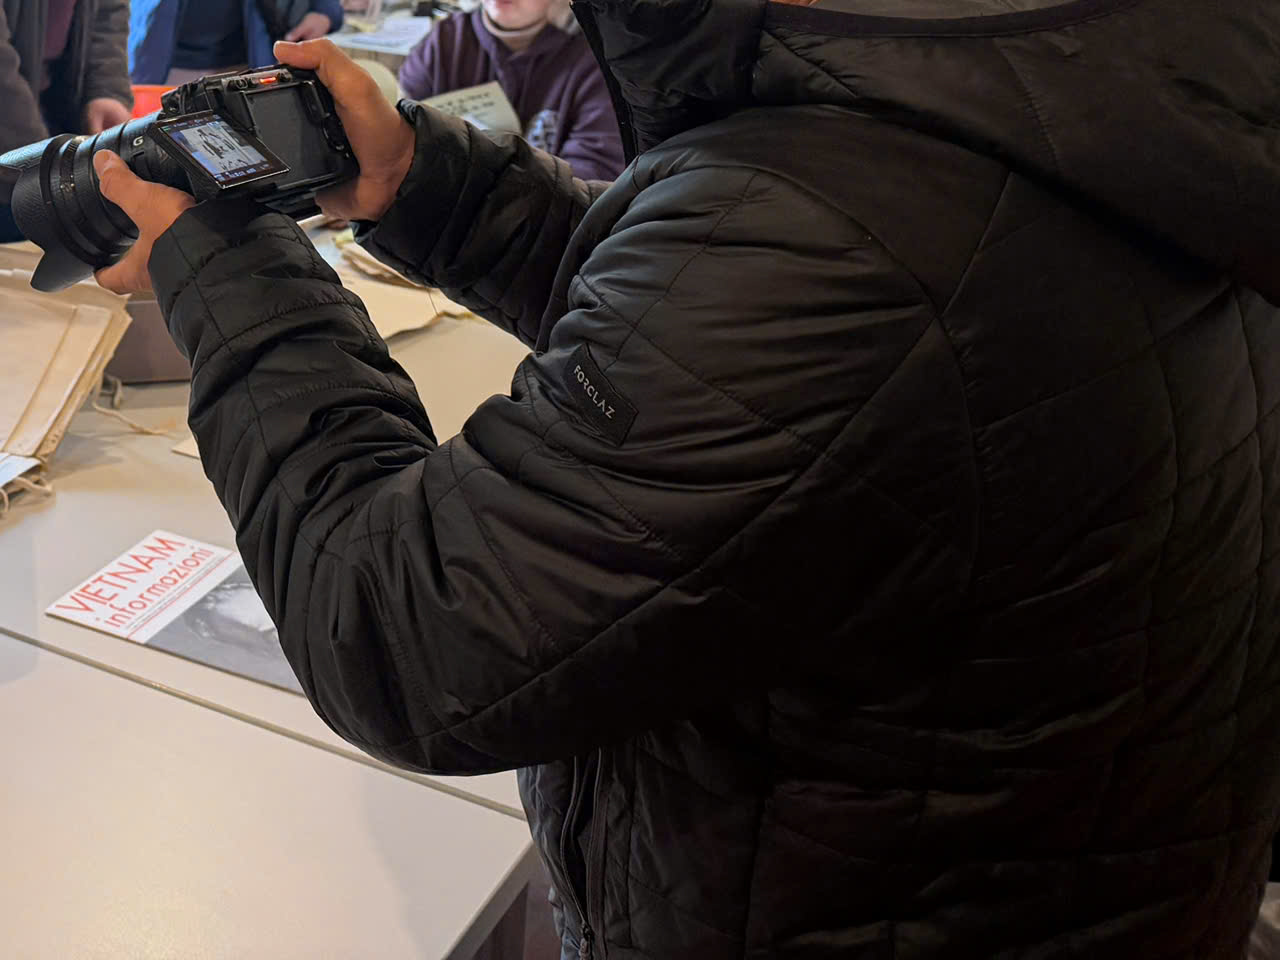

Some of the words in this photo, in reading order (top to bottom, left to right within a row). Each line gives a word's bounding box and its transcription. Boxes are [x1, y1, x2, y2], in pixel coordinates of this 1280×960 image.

[573, 364, 616, 419] FORCLAZ
[56, 536, 186, 614] VIETNAM
[96, 544, 214, 628] informazioni
